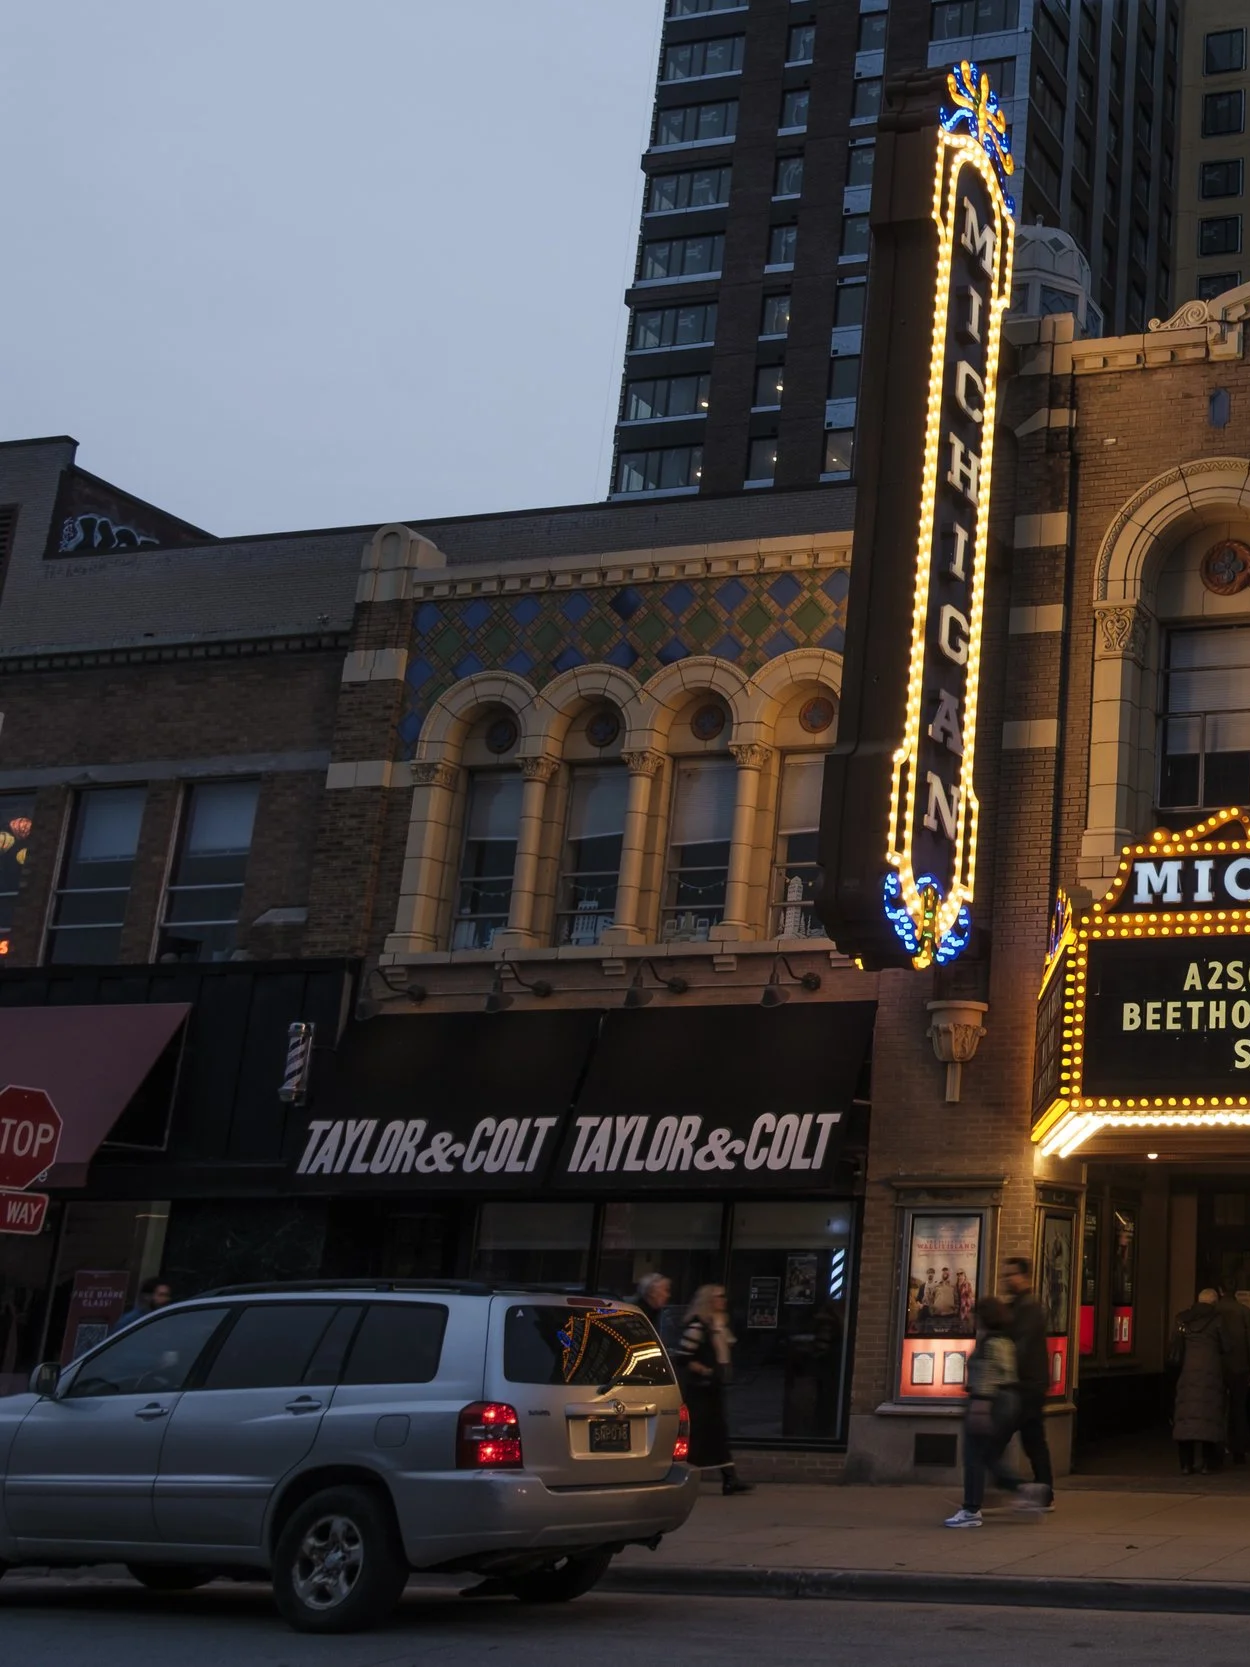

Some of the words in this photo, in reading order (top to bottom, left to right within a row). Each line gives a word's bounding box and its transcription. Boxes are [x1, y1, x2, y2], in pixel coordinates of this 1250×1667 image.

[922, 194, 998, 842] MICHIGAN
[0, 1117, 55, 1158] TOP
[6, 1200, 43, 1225] WAY
